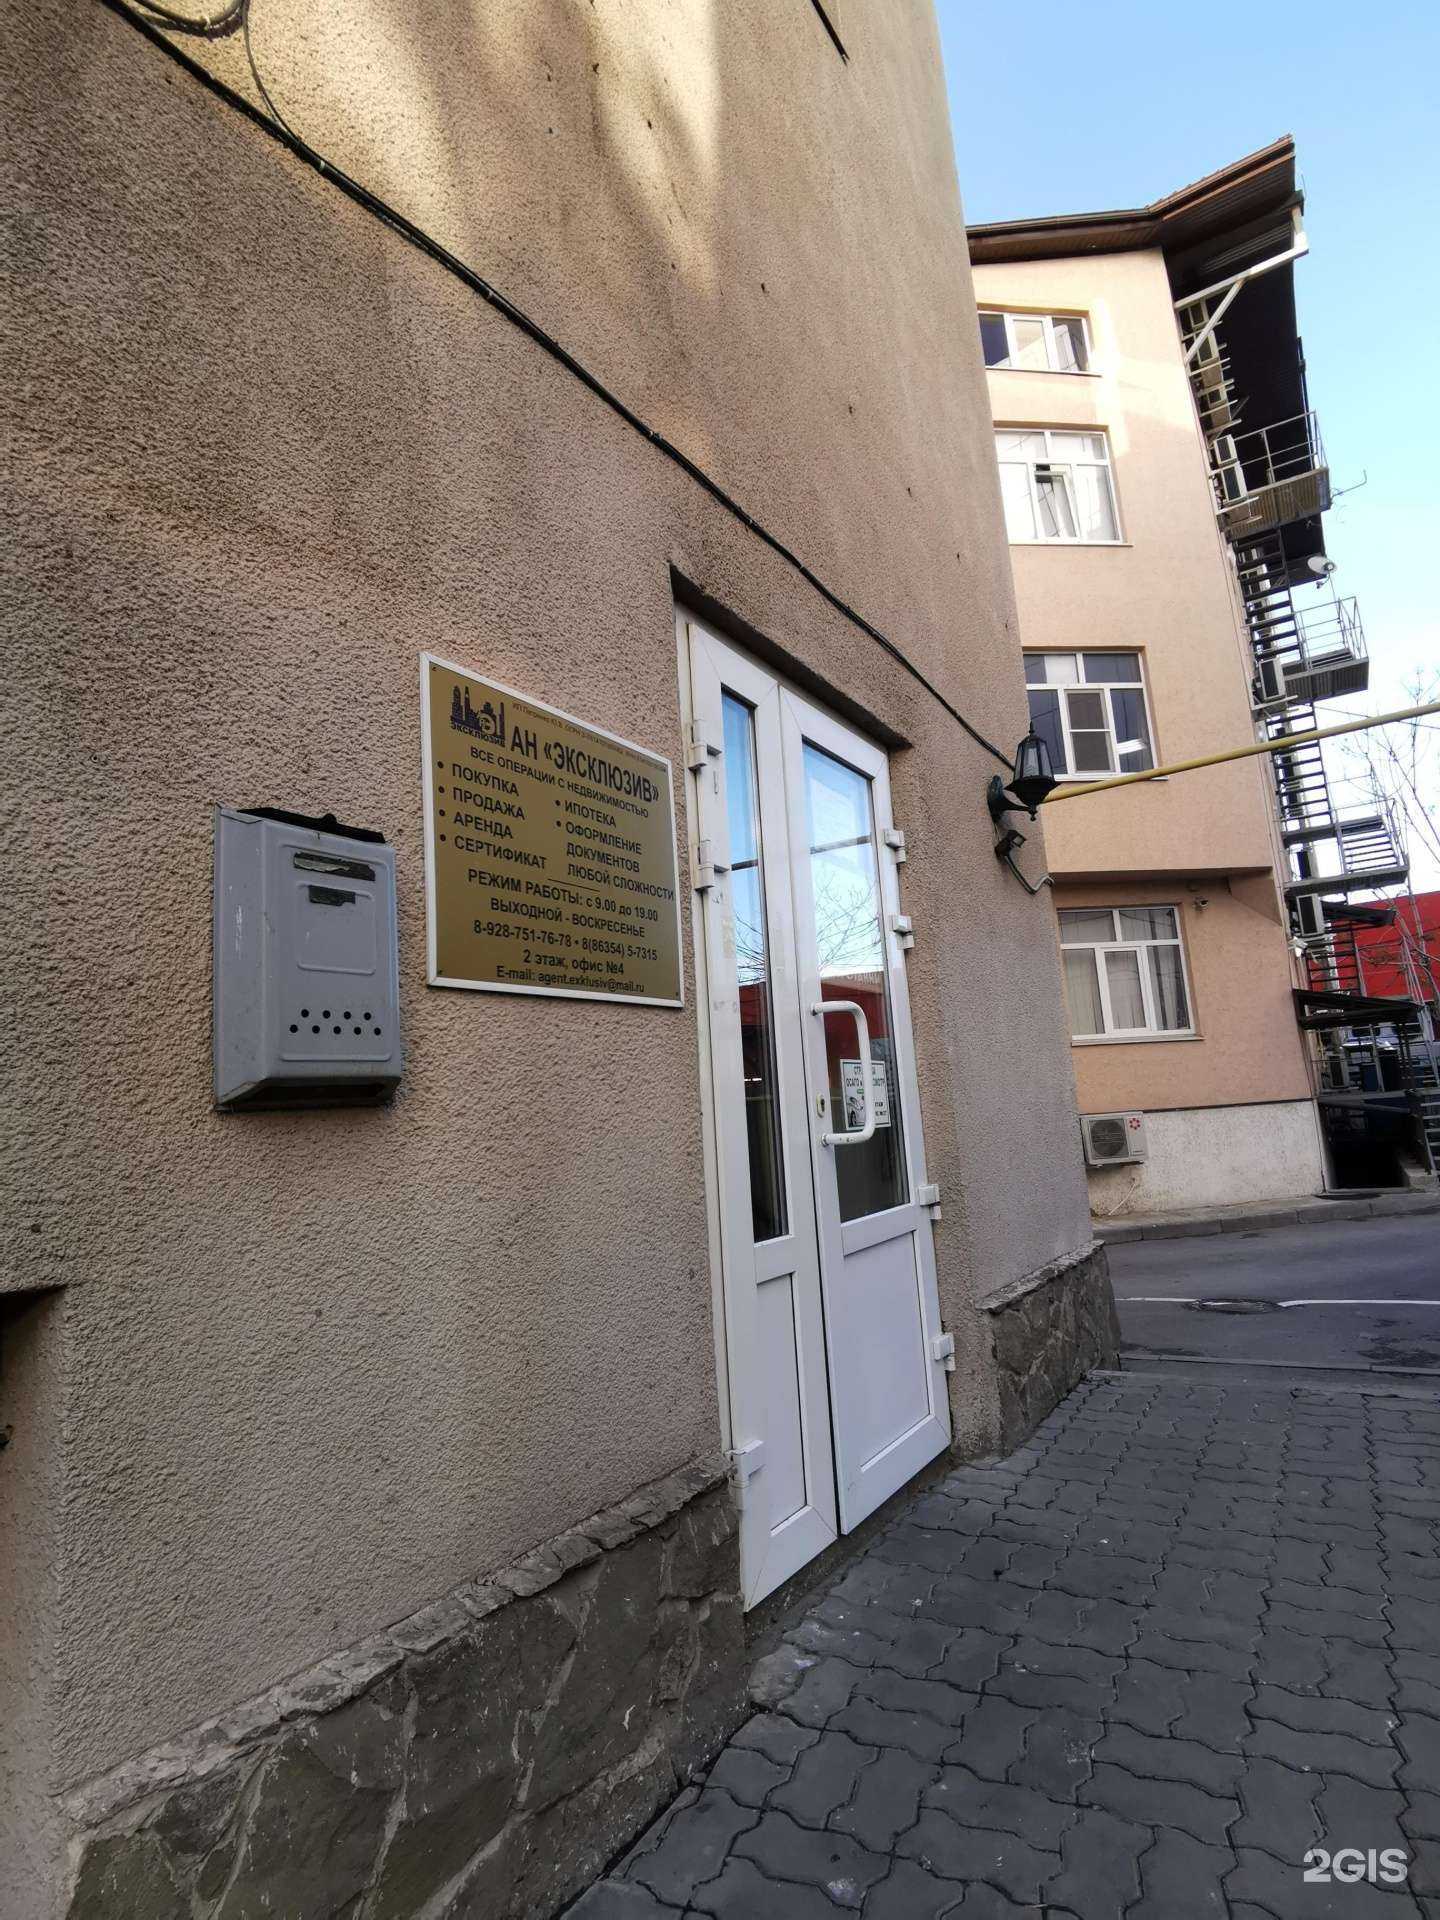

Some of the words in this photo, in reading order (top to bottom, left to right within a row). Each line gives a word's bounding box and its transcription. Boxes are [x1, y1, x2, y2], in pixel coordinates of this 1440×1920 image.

[450, 722, 505, 748] ЭКСКЛЮЗИВ
[452, 763, 520, 797] ПОКУПКА
[510, 725, 538, 761] АН
[544, 741, 660, 803] «ЭКСКЛЮЗИВ»
[470, 745, 495, 765] ВСЕ
[497, 756, 556, 785] ОПЕРАЦИИ
[558, 778, 565, 788] С
[567, 781, 649, 818] НЕДВИЖИМОСТЬЮ
[453, 787, 525, 820] ПРОДАЖА
[564, 800, 617, 828] ИПОТЕКА
[453, 812, 513, 839] АРЕНДА
[565, 821, 642, 855] ОФОРМЛЕНИЕ
[454, 835, 547, 869] СЕРТИФИКАТ
[566, 842, 640, 873] ДОКУМЕНТОВ
[468, 868, 521, 893] РЕЖИМ
[525, 881, 583, 906] РАБОТЫ:
[594, 896, 617, 913] 9.00
[619, 905, 632, 916] до
[634, 906, 658, 921] 19.00
[567, 863, 611, 885] ЛЮБОЙ
[613, 875, 674, 901] СЛОЖНОСТИ
[490, 897, 562, 922] ВЫХОДНОЙ
[572, 913, 645, 938] ВОСКРЕСЕНЬЕ
[474, 919, 572, 948] 8-928-751-76-78
[582, 937, 625, 958] 8(86354)
[627, 945, 658, 961] 5-7315
[496, 965, 534, 981] E-mail:
[523, 948, 531, 963] 2
[535, 954, 569, 970] этаж,
[572, 957, 604, 973] офис
[606, 961, 624, 975] №4
